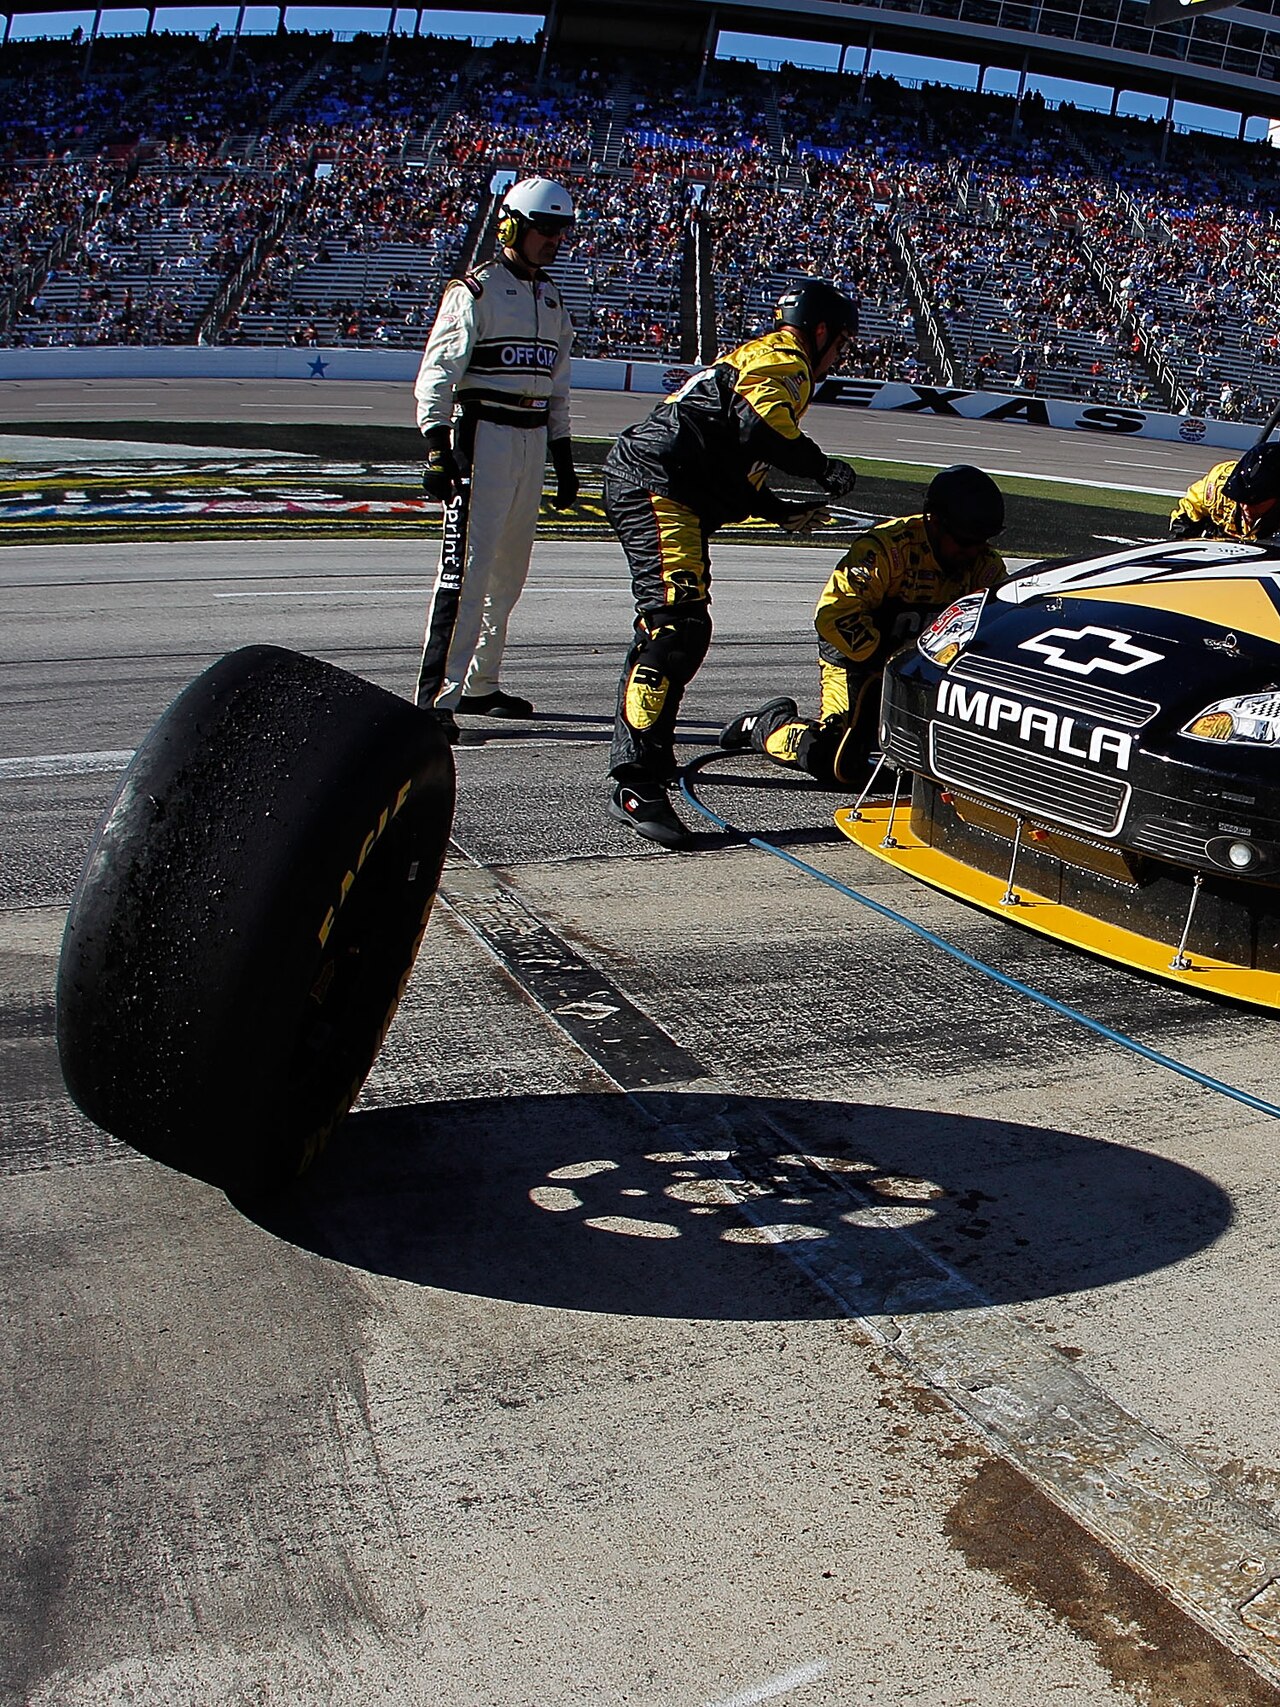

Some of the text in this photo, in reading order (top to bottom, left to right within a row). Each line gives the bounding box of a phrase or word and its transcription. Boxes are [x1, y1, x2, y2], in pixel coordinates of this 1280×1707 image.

[813, 378, 1147, 434] EXAS
[444, 495, 463, 568] Sprint
[936, 679, 1132, 771] IMPALA
